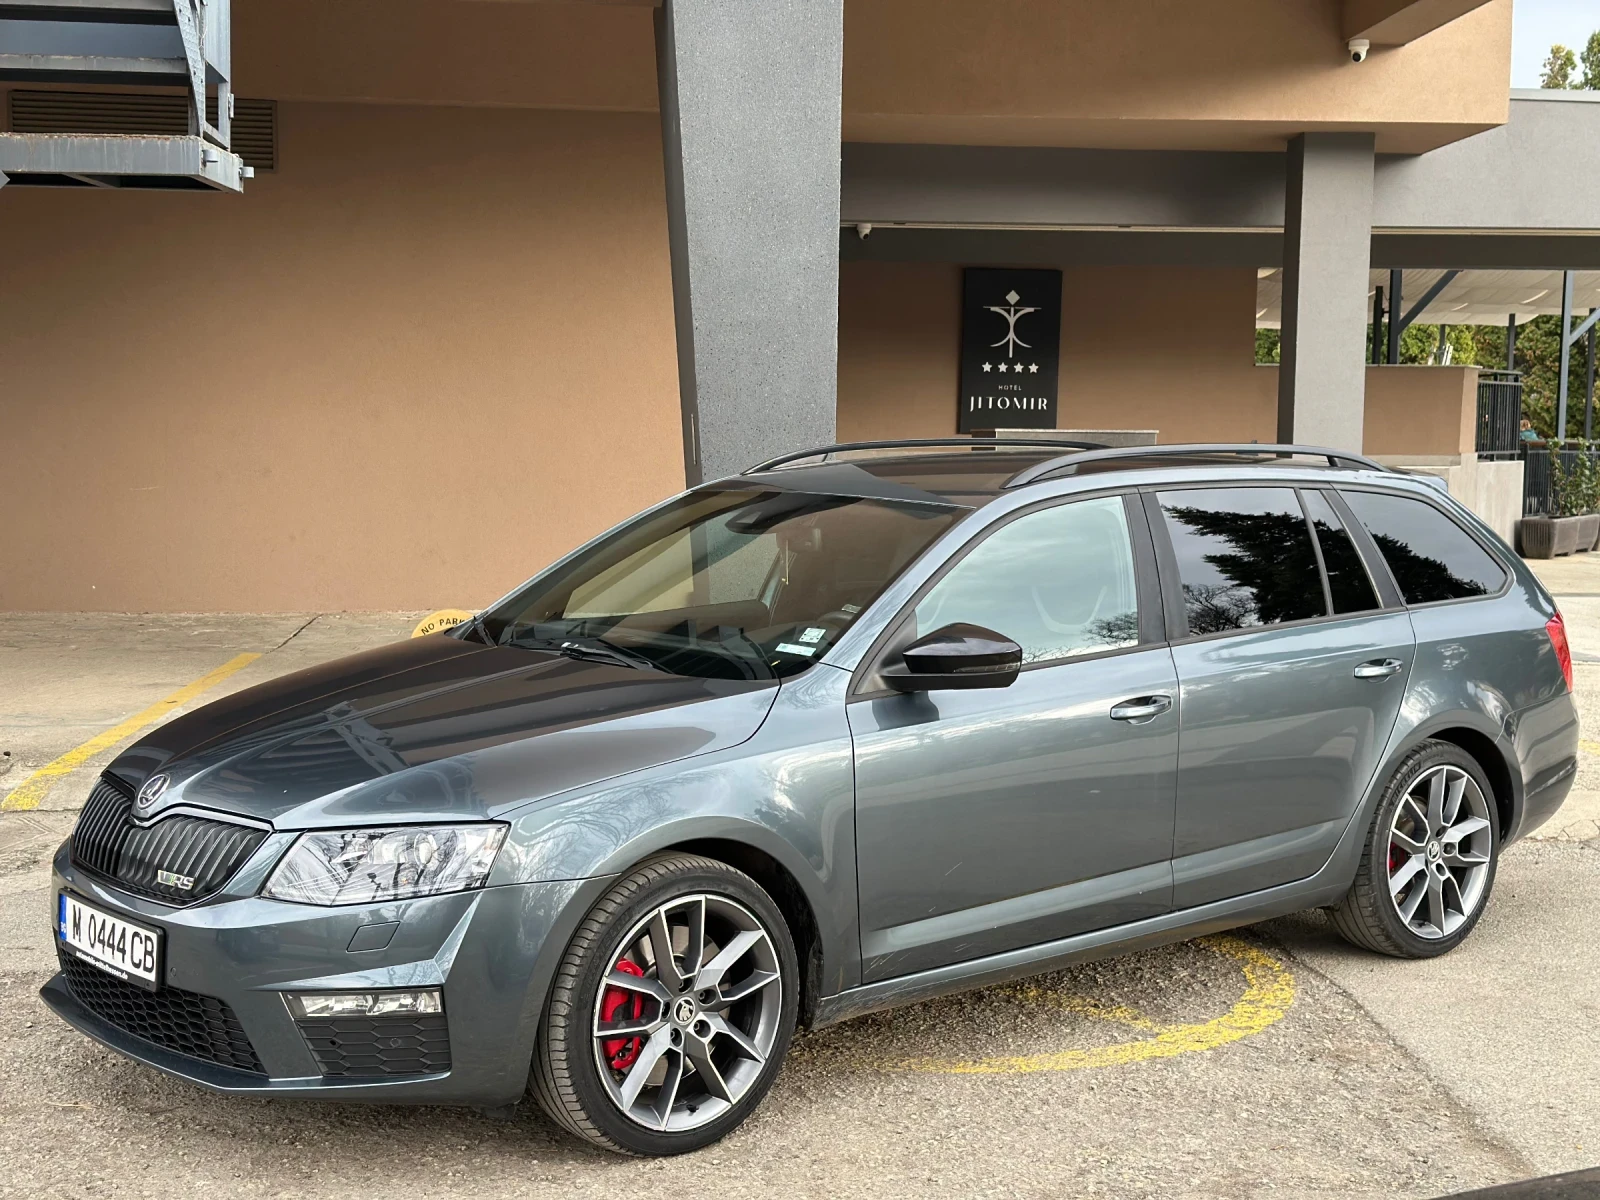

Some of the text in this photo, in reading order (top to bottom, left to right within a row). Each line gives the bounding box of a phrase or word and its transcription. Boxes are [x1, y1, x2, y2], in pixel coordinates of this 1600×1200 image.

[970, 396, 1048, 412] JITOMIR
[421, 622, 435, 635] NO
[72, 904, 82, 943] M
